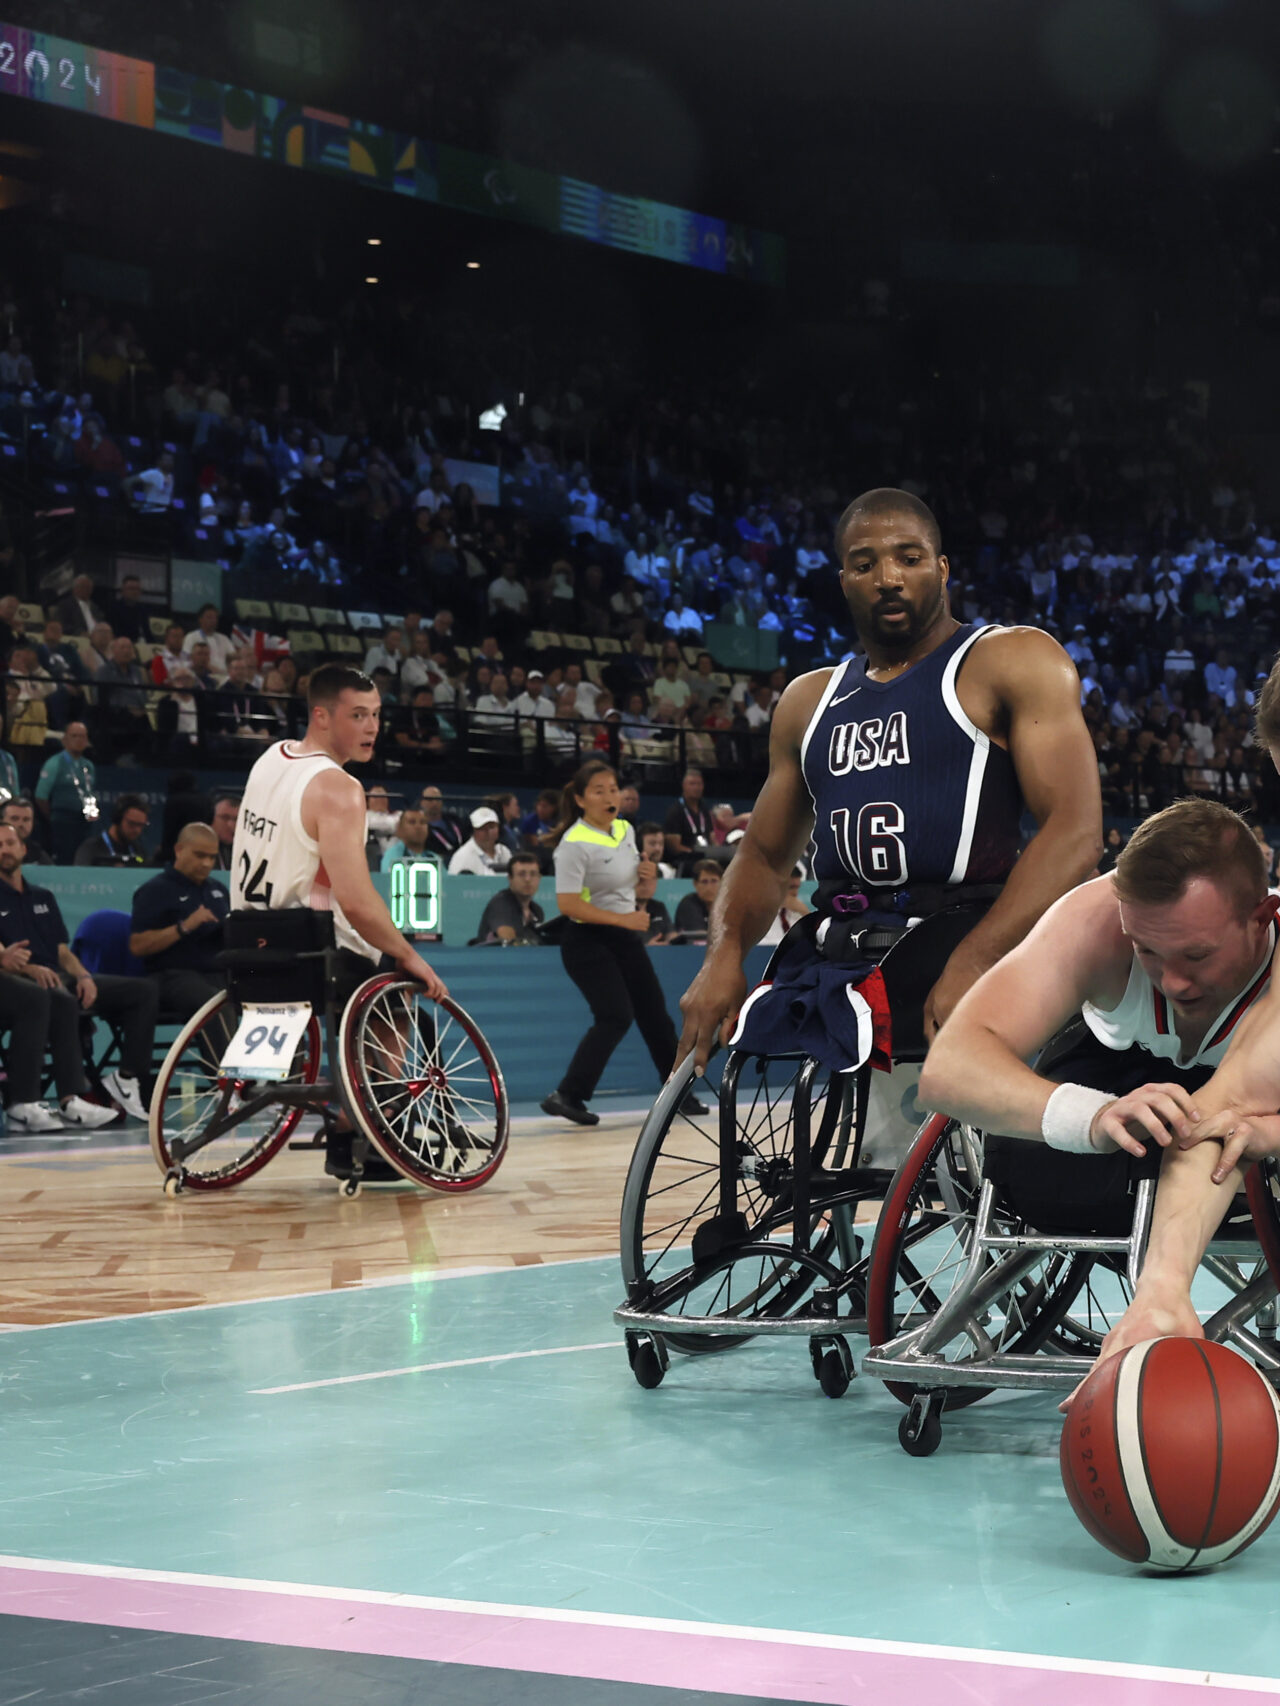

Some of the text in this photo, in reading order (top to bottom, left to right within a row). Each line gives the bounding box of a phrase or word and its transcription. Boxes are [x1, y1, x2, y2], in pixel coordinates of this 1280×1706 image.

[828, 710, 910, 777] USA
[830, 801, 909, 888] 16
[256, 1006, 286, 1015] Allianz
[244, 1025, 289, 1055] 94
